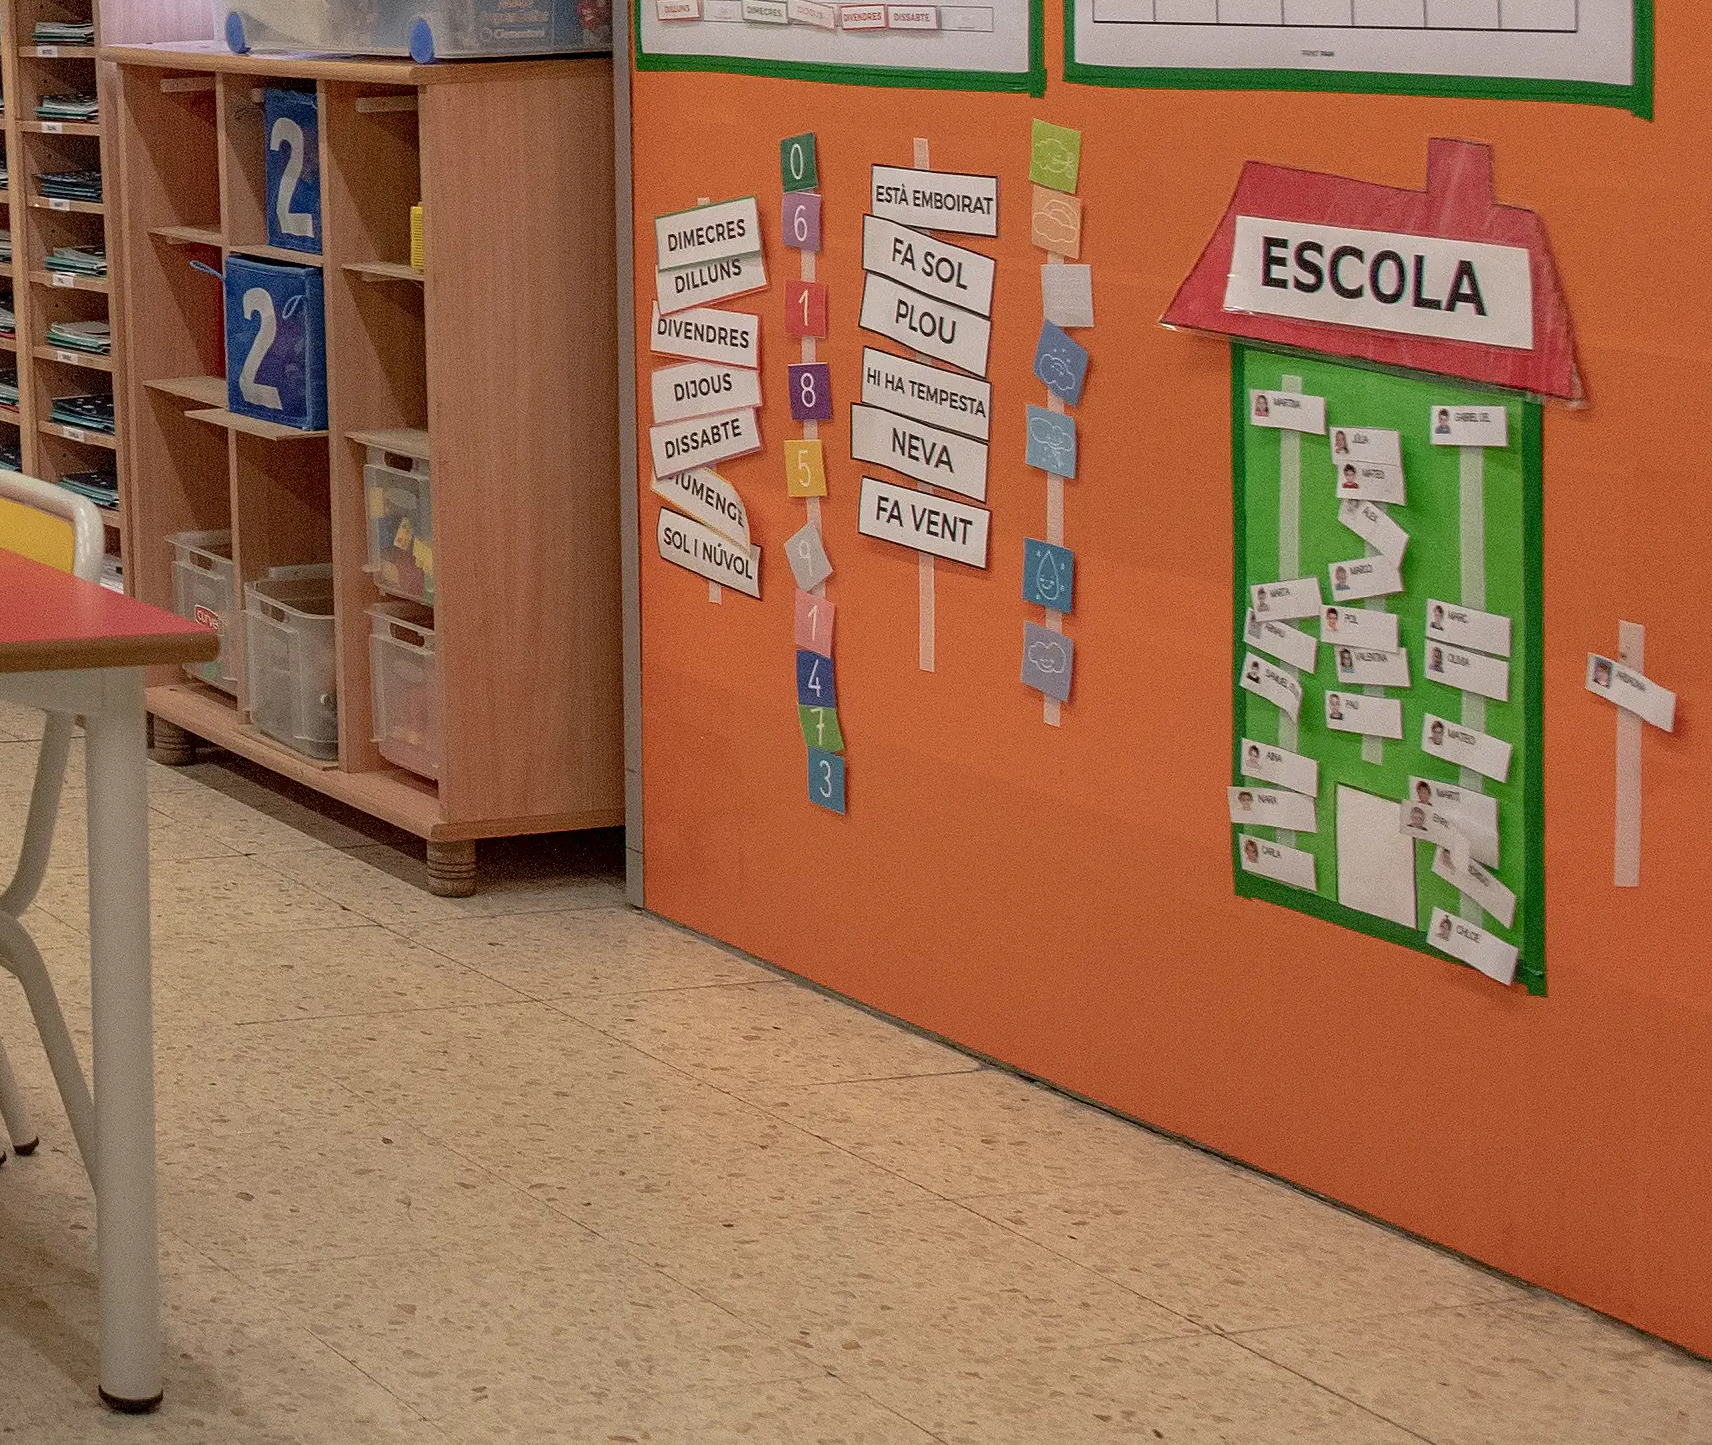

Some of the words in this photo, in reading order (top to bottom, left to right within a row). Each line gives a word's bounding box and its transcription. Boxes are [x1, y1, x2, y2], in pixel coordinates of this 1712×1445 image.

[892, 12, 931, 23] DISSABTE
[270, 117, 315, 238] 2
[790, 148, 804, 177] 0
[875, 181, 909, 209] ESTÀ
[913, 188, 995, 218] EMBOIRAT
[667, 219, 747, 254] DIMECRES
[793, 211, 808, 242] 6
[675, 257, 742, 295] DILLUNS
[891, 237, 918, 268] FA
[923, 250, 968, 291] SOL
[1261, 235, 1488, 319] ESCOLA
[798, 294, 810, 324] 1
[894, 300, 958, 346] PLOU
[239, 287, 284, 411] 2
[658, 317, 750, 350] DIVENDRES
[673, 372, 733, 401] DIJOUS
[800, 373, 816, 408] 8
[867, 366, 882, 389] HI
[886, 371, 905, 396] HA
[909, 376, 987, 420] TEMPESTA
[664, 419, 743, 460] DISSABTE
[891, 426, 955, 475] NEVA
[797, 449, 812, 483] 5
[875, 495, 904, 526] FA
[910, 502, 974, 547] VENT
[663, 526, 691, 552] SOL
[693, 540, 699, 558] I
[701, 542, 754, 582] NÚVOL
[798, 544, 813, 577] 9
[806, 606, 818, 639] 1
[807, 660, 822, 696] 4
[810, 708, 827, 746] 7
[818, 761, 833, 799] 3
